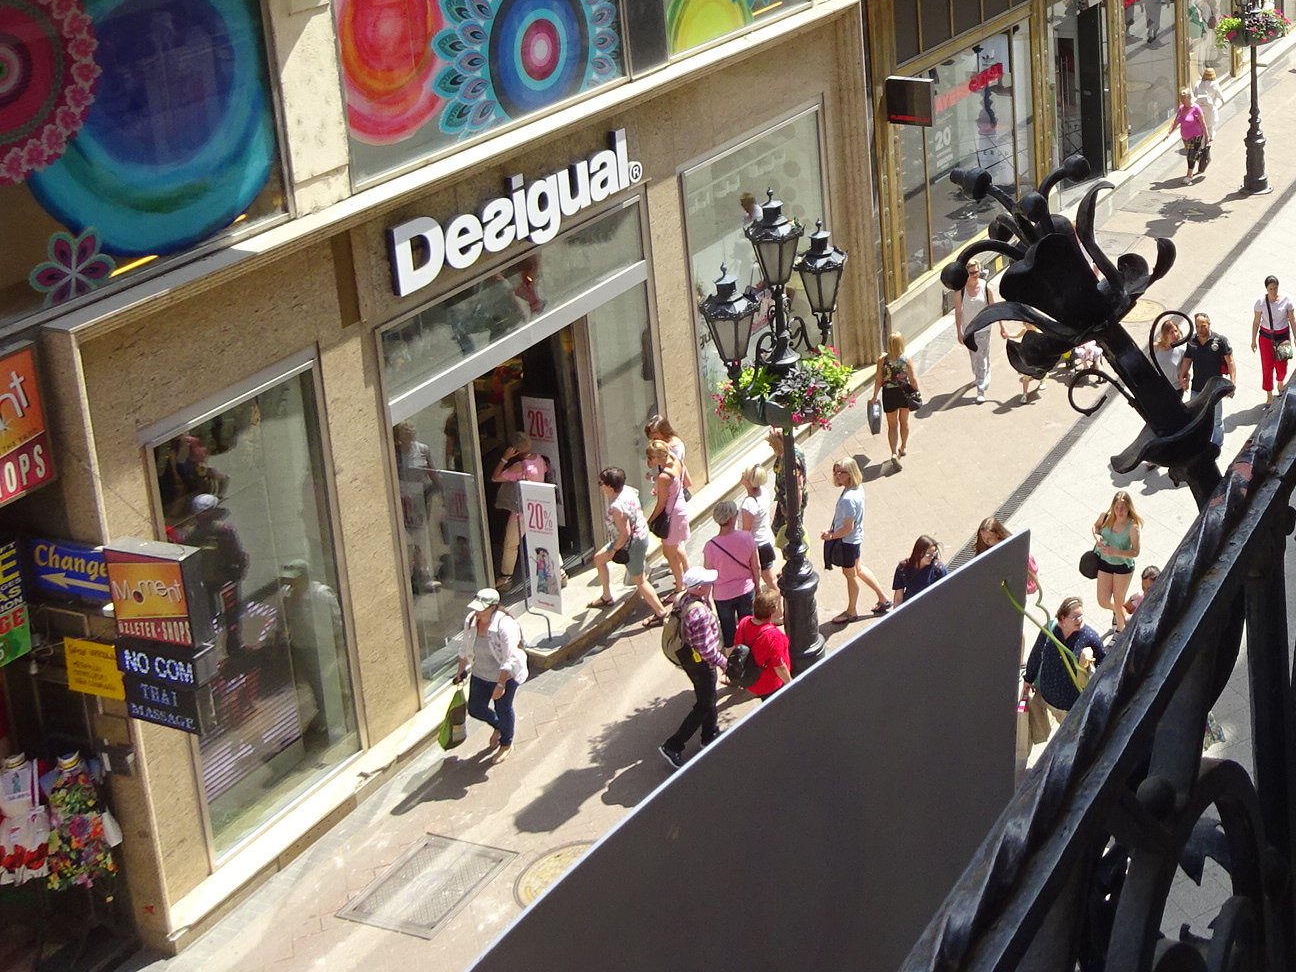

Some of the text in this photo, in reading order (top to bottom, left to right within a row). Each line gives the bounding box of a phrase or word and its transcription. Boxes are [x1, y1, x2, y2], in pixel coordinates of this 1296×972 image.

[527, 410, 554, 439] 20%
[0, 444, 46, 498] OPS
[526, 502, 553, 530] 20%
[34, 544, 107, 581] Change
[112, 579, 183, 604] Moment
[161, 621, 193, 644] SHOPS
[124, 649, 151, 674] NO
[154, 656, 195, 684] COM
[139, 683, 179, 707] THAI
[129, 702, 197, 730] MASSAGE
